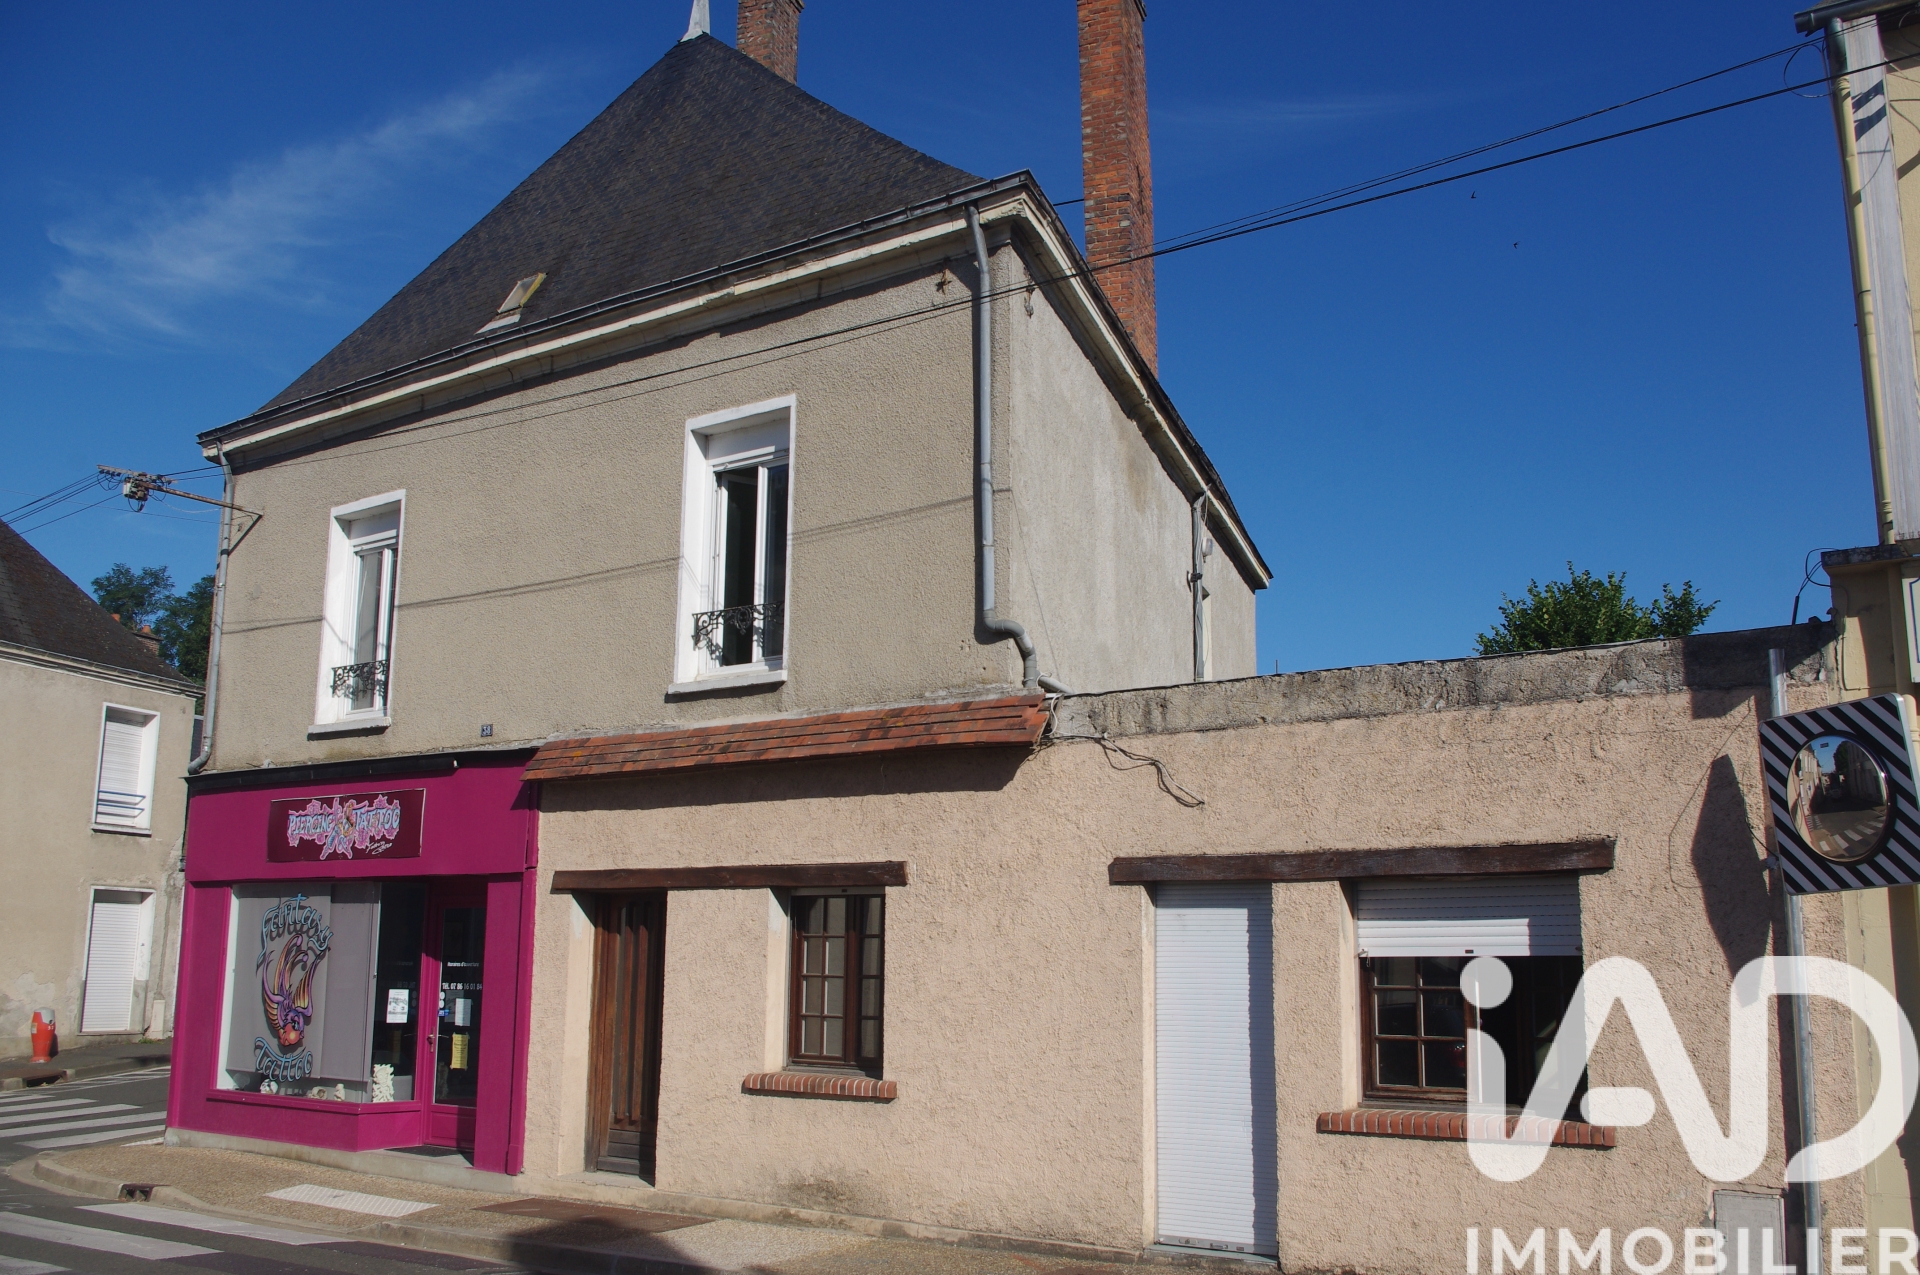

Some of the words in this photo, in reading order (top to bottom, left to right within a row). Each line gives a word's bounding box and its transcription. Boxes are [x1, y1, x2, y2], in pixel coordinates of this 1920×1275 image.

[287, 812, 334, 835] PIERCING
[353, 807, 400, 830] TATTOO
[257, 893, 333, 963] Fantasy
[255, 1036, 313, 1082] Tattoo
